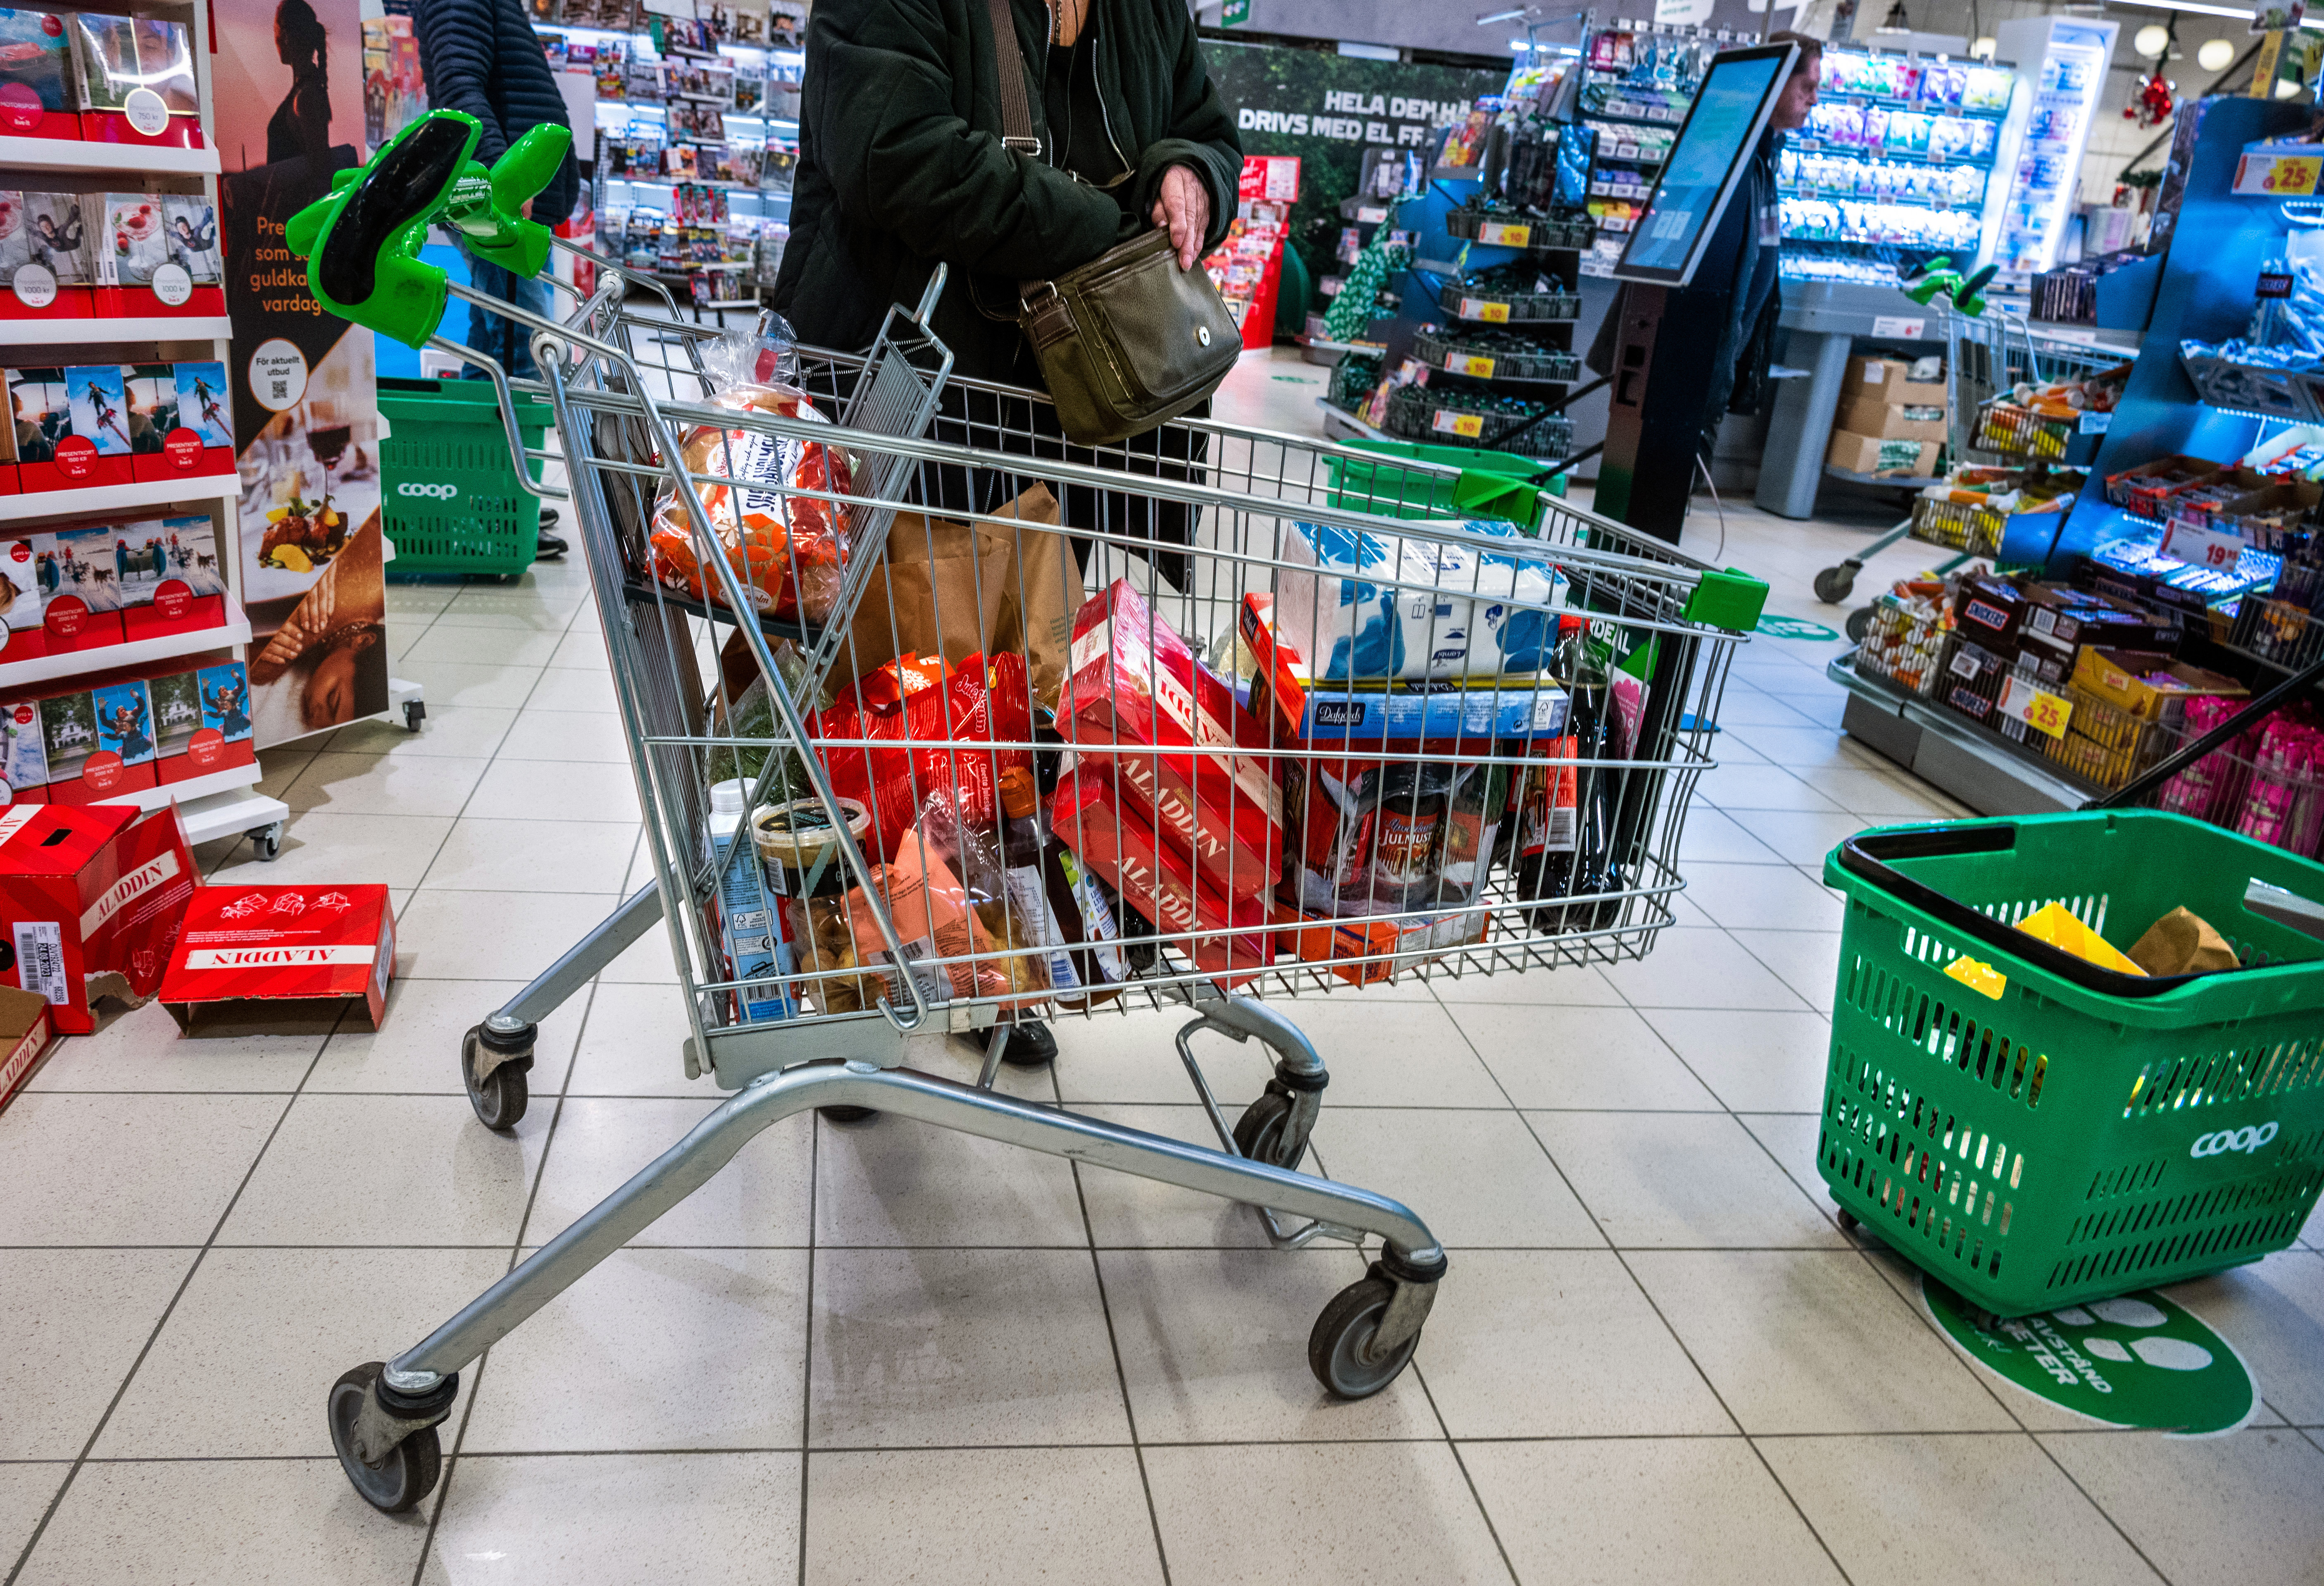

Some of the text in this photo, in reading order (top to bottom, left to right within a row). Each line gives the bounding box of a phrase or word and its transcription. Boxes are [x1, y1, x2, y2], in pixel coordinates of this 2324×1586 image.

[1325, 90, 1386, 116] HELA
[1238, 108, 1308, 135] DRIVS
[1312, 116, 1363, 141] MED
[1365, 122, 1394, 144] EL
[2281, 167, 2306, 187] 25
[1510, 232, 1523, 243] 10
[255, 248, 289, 261] som
[250, 268, 307, 292] guldka
[1490, 308, 1503, 319] 10
[256, 356, 300, 366] För aktuellt
[1475, 363, 1488, 373] 10
[267, 367, 290, 377] utbud
[1463, 422, 1476, 433] 10
[398, 483, 457, 500] coop
[2207, 544, 2226, 564] 19
[157, 591, 189, 601] PRESENTKORT
[49, 608, 85, 618] PRESENTKORT
[1967, 601, 2008, 628] SNICKERS
[1319, 705, 1360, 725] Dafgåds
[2037, 704, 2060, 728] 25
[86, 762, 120, 773] PRESENTKORT
[1117, 758, 1227, 859] ALADDIN
[98, 861, 163, 921] ALADDIN
[38, 944, 51, 977] 24.08.2023
[212, 949, 337, 965] ALADDIN
[2190, 1121, 2279, 1158] coop
